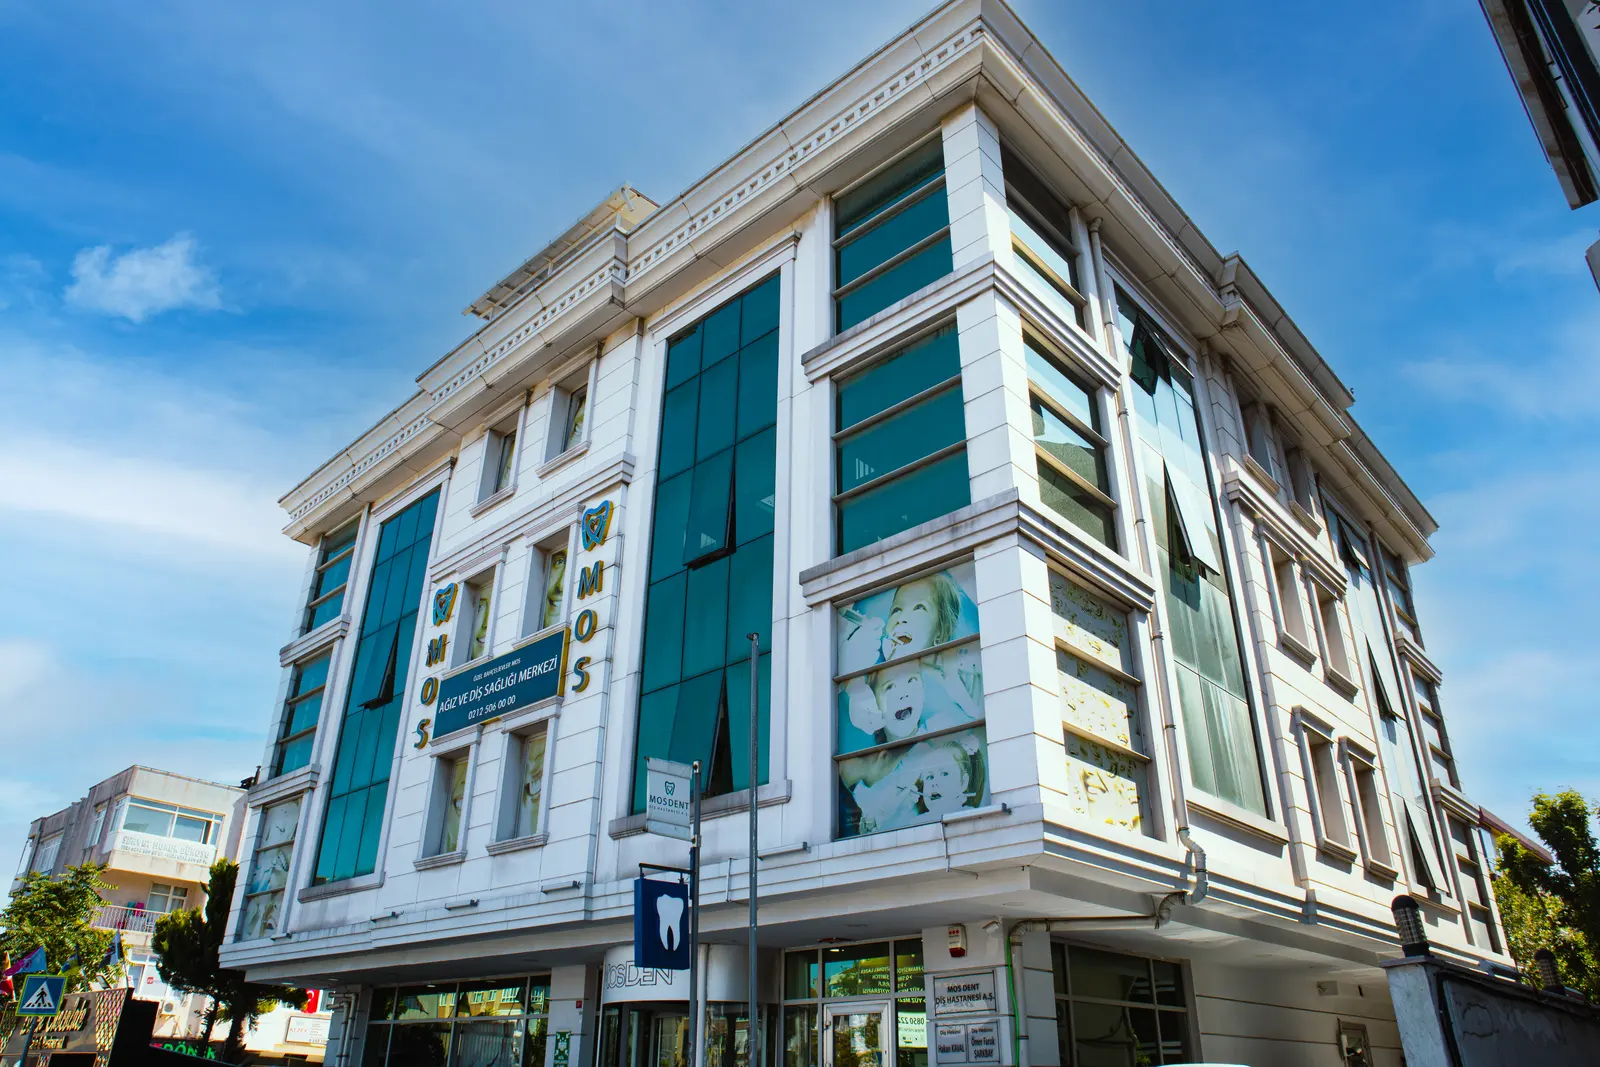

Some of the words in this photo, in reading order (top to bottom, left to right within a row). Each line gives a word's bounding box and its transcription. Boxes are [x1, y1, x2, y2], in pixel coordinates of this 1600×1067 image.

[438, 697, 457, 713] AĞIZ
[458, 692, 468, 705] VE
[469, 686, 482, 701] DİŞ
[484, 673, 517, 696] SAĞLIĞI
[518, 654, 558, 683] MERKEZİ
[468, 708, 484, 720] 0212
[485, 703, 496, 714] 506
[498, 698, 506, 708] 00
[507, 695, 516, 704] 00
[649, 795, 689, 810] MOSDENT
[607, 961, 673, 989] OSDEN
[963, 983, 979, 991] DENT
[947, 992, 981, 1003] HASTANESİ
